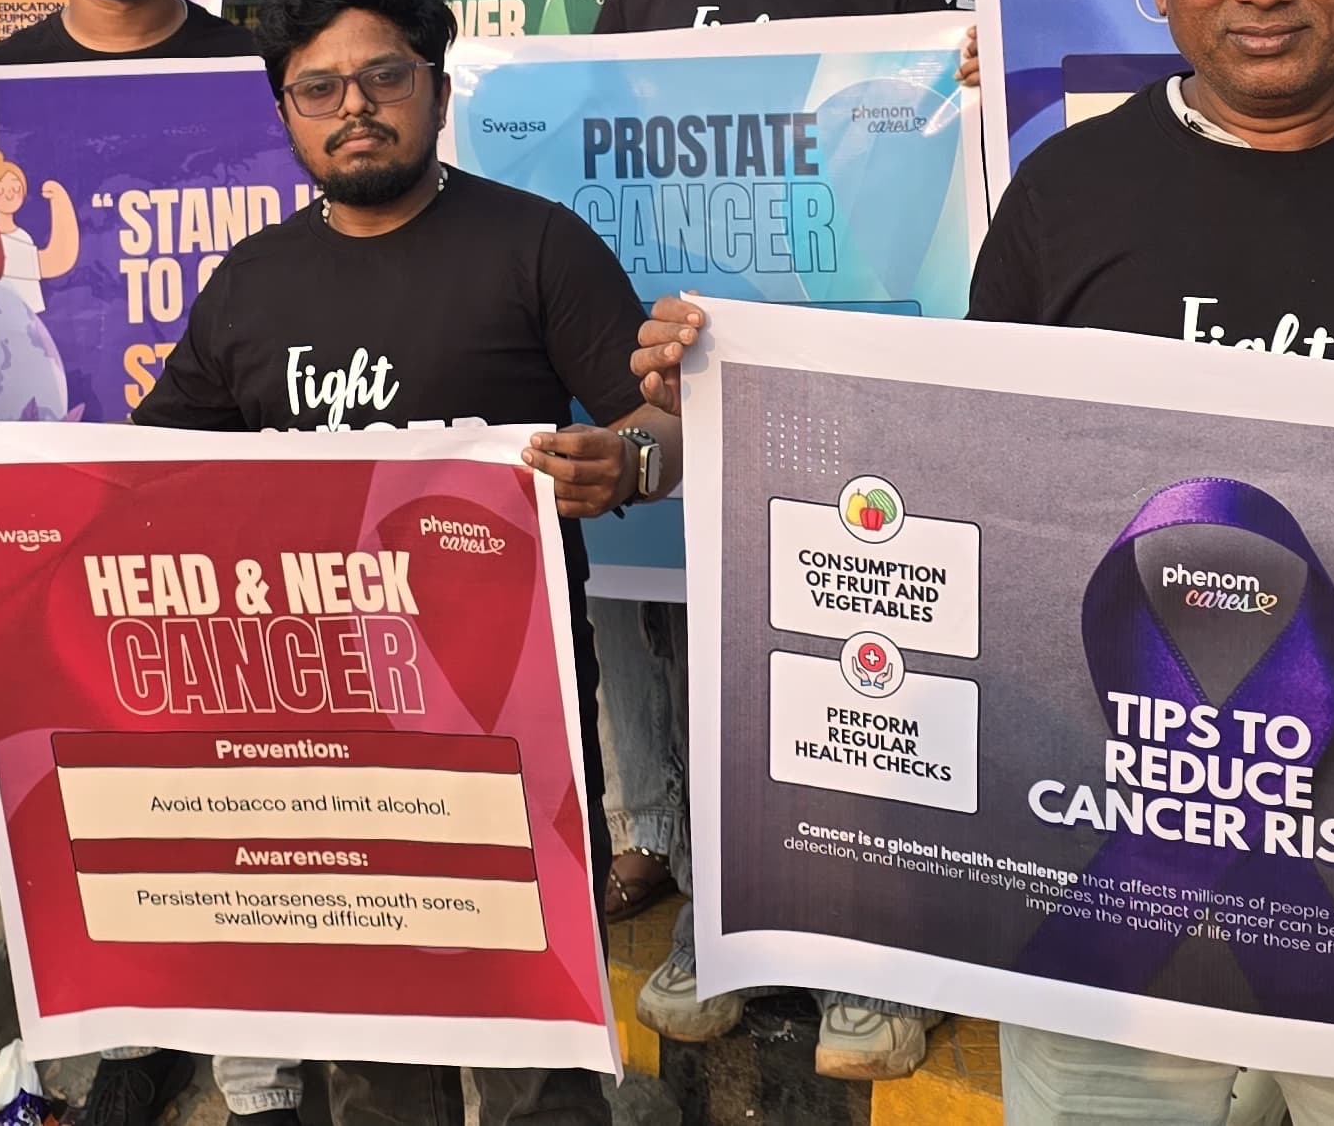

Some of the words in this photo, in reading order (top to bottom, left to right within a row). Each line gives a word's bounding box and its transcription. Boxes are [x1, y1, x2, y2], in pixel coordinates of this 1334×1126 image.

[482, 118, 547, 134] Swaasa
[852, 105, 915, 122] phenom
[583, 112, 820, 179] PROSTATE
[573, 181, 838, 274] CANCER
[119, 257, 184, 324] TO
[287, 345, 400, 433] Fight
[420, 515, 491, 538] phenom
[439, 534, 492, 554] cares
[83, 554, 221, 616] HEAD
[234, 559, 273, 616] &
[280, 551, 420, 615] NECK
[798, 549, 947, 586] CONSUMPTION
[1162, 563, 1260, 593] phenom
[806, 570, 832, 589] OF
[836, 574, 891, 597] FRUIT
[895, 583, 939, 603] AND
[1185, 587, 1257, 613] cares
[811, 589, 934, 623] VEGETABLES
[106, 616, 426, 715] CANCER
[826, 706, 919, 737] PERFORM
[1107, 690, 1221, 749] TIPS
[1233, 709, 1312, 760] TO
[215, 739, 350, 760] Prevention:
[828, 726, 919, 757] REGULAR
[795, 740, 867, 768] HEALTH
[873, 754, 952, 782] CHECKS
[1105, 739, 1314, 810] REDUCE
[150, 795, 202, 812] Avoid
[207, 795, 286, 812] tobacco
[291, 795, 327, 812] and
[332, 795, 372, 812] limit
[377, 796, 450, 816] alcohol.
[1027, 779, 1251, 852] CANCER
[235, 846, 369, 867] Awareness:
[798, 821, 856, 843] Cancer
[858, 830, 872, 846] is
[874, 836, 885, 849] a
[887, 837, 938, 859] global
[941, 846, 994, 869] health
[996, 855, 1079, 885] challenge
[1082, 872, 1115, 891] that
[1119, 878, 1177, 899] affects
[1181, 888, 1244, 909] millions
[1248, 897, 1267, 910] of
[1270, 900, 1330, 921] people
[137, 889, 231, 907] Persistent
[236, 890, 352, 909] hoarseness,
[356, 892, 418, 910] mouth
[422, 894, 480, 914] sores,
[783, 836, 859, 862] detection,
[862, 849, 893, 867] and
[896, 854, 964, 880] healthier
[967, 868, 1026, 891] lifestyle
[1029, 880, 1094, 905] choices,
[1098, 892, 1125, 908] the
[1129, 898, 1189, 920] impact
[1193, 907, 1210, 921] of
[1214, 910, 1274, 929] cancer
[1279, 919, 1312, 934] can
[214, 910, 317, 929] swallowing
[322, 910, 408, 930] difficulty.
[1025, 894, 1092, 919] improve
[1095, 908, 1122, 924] the
[1126, 914, 1182, 938] quality
[1186, 923, 1205, 937] of
[1207, 925, 1232, 942] life
[1235, 929, 1258, 944] for
[1263, 933, 1311, 951] those
